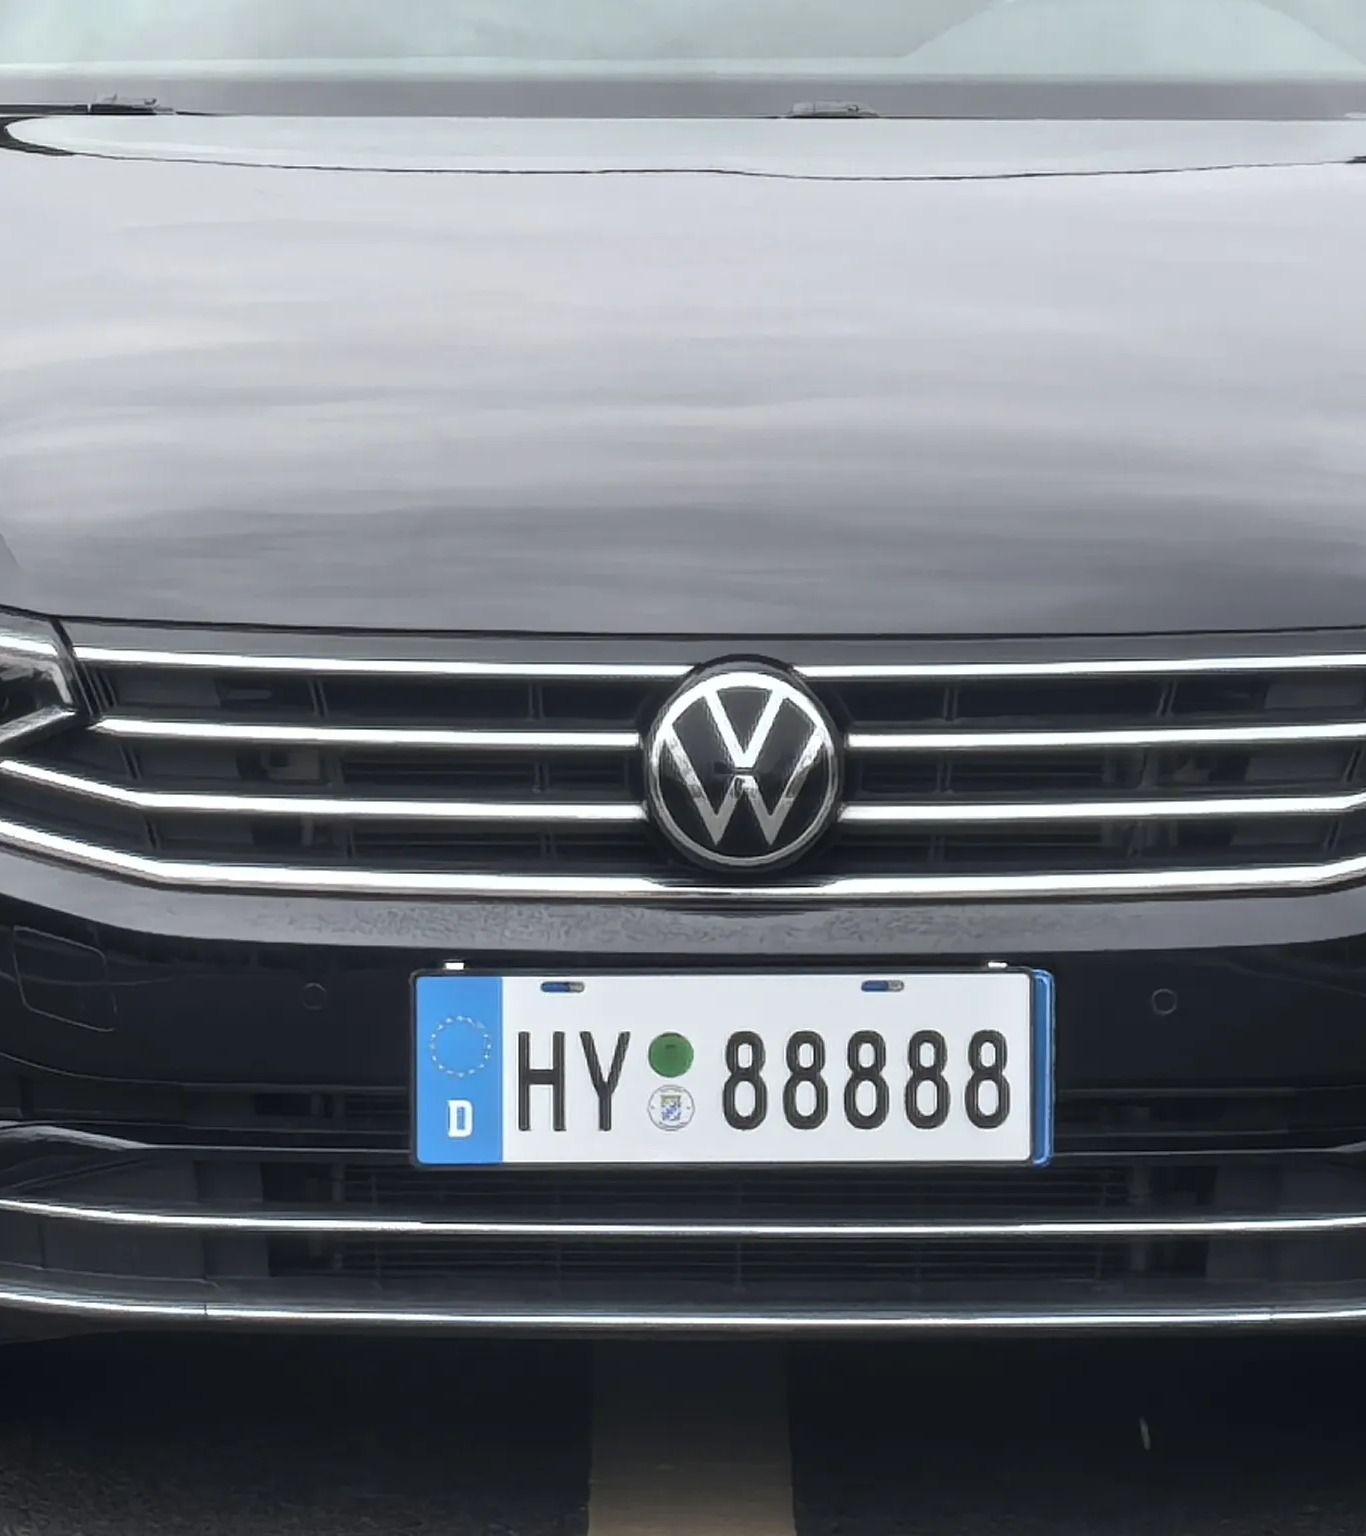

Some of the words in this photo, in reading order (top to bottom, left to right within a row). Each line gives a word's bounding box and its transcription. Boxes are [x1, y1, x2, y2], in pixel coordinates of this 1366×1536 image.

[657, 682, 832, 848] VW
[447, 1099, 474, 1138] D
[517, 1030, 631, 1132] HY
[721, 1028, 1011, 1132] 88888
